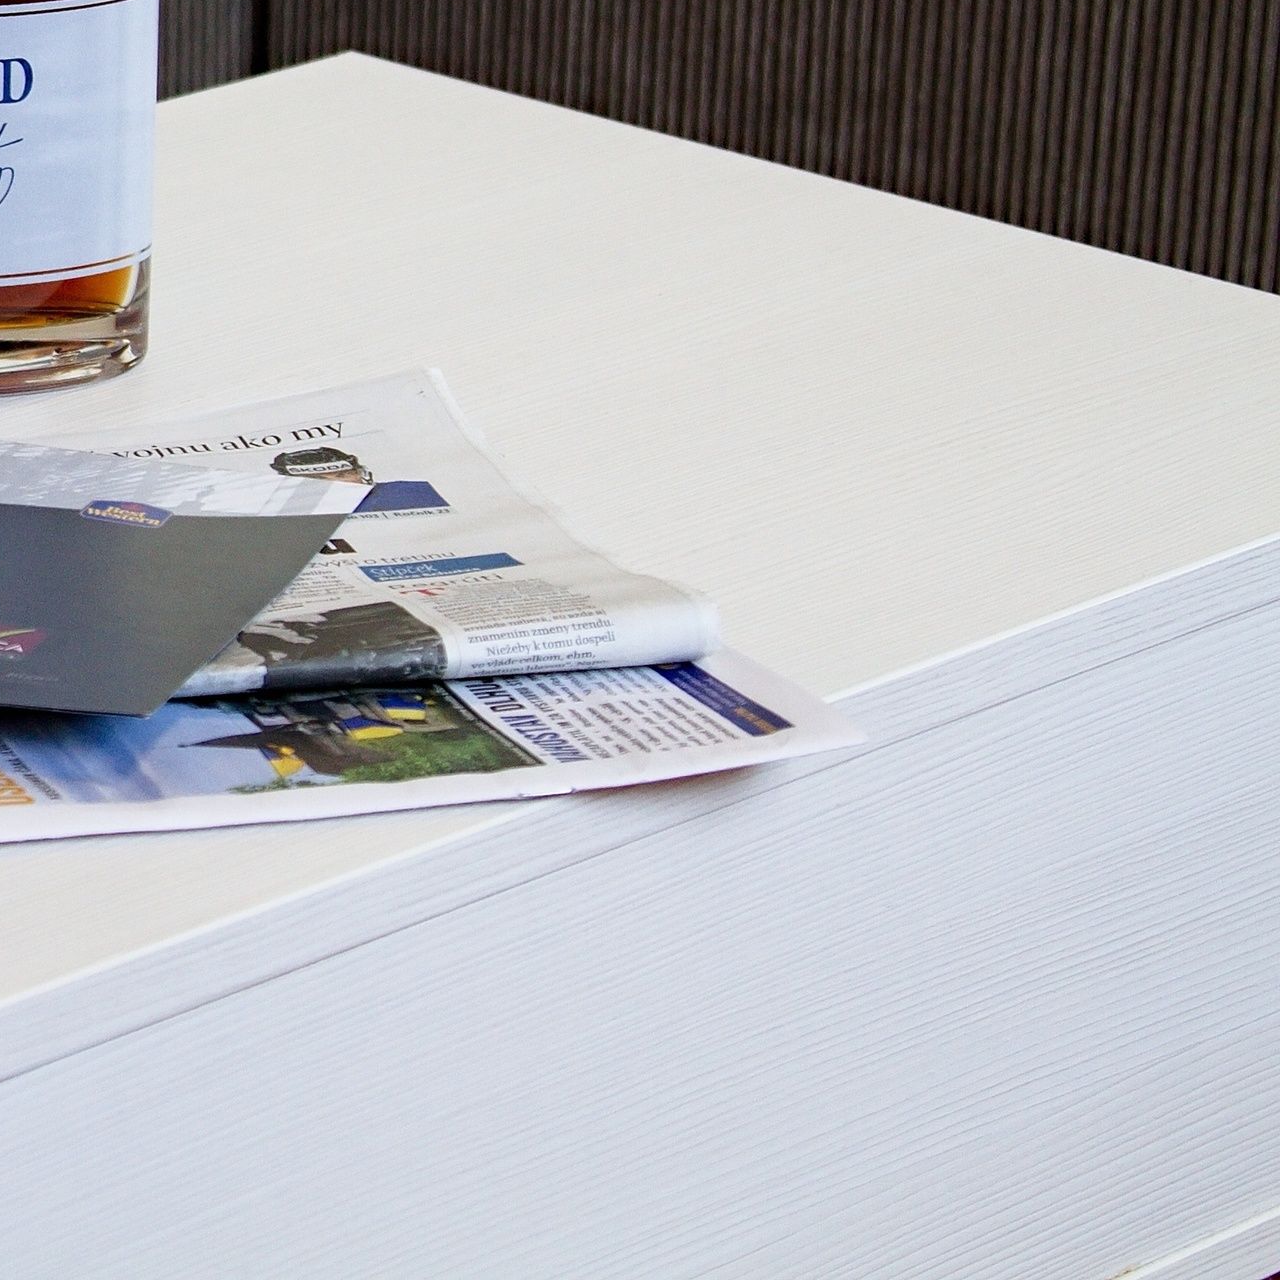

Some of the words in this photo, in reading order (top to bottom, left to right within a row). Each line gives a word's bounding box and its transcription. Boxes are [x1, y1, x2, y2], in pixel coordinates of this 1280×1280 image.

[112, 442, 212, 461] vojnu
[221, 434, 283, 452] ako
[290, 421, 345, 439] my
[543, 639, 573, 650] tomu
[576, 632, 616, 647] dospeli
